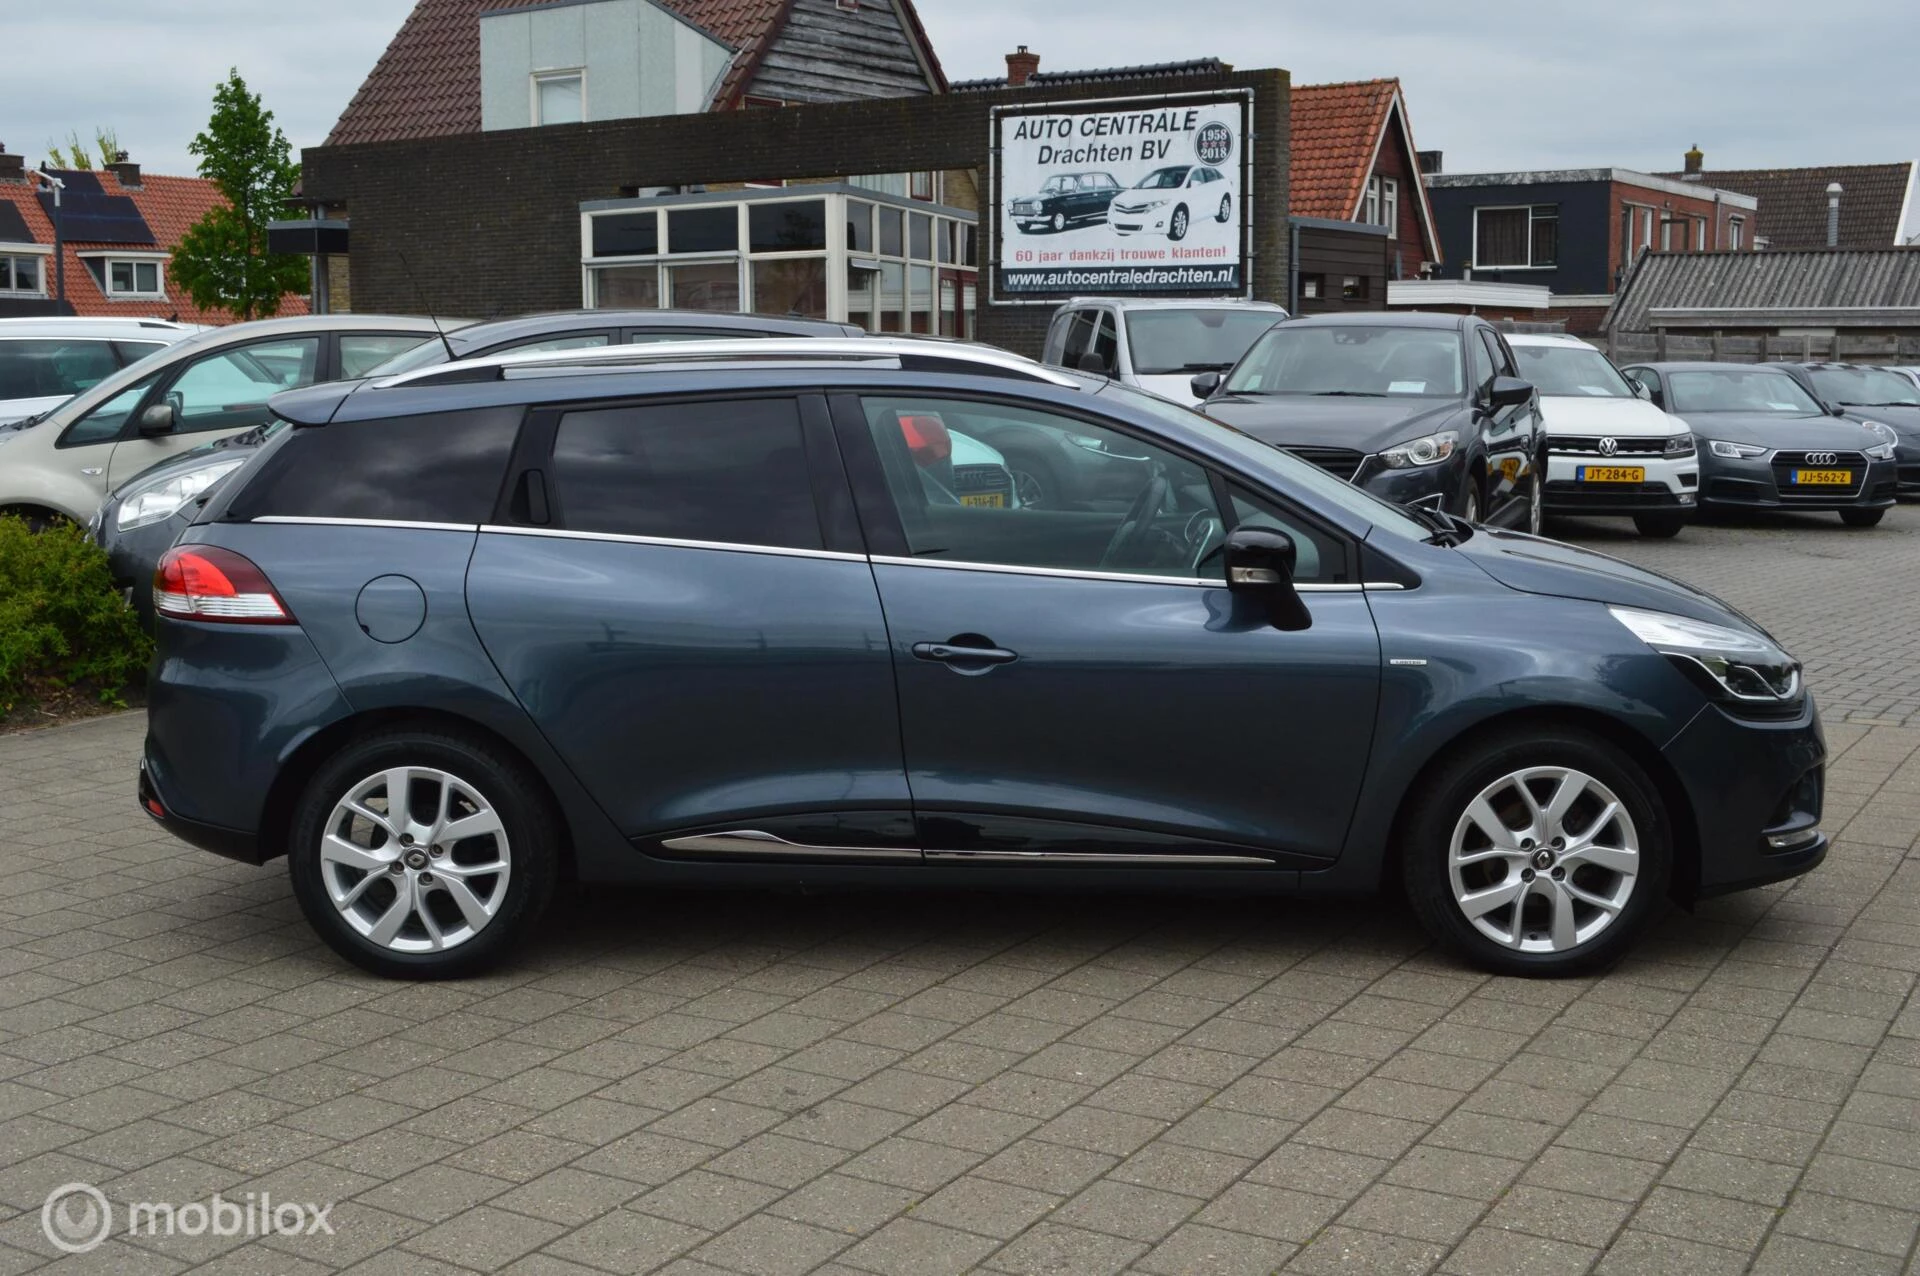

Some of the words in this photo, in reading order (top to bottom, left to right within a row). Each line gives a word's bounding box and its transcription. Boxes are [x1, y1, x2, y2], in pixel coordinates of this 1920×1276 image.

[1014, 118, 1073, 140] AUTO
[1080, 111, 1199, 136] CENTRALE
[1202, 128, 1227, 141] 1958
[1038, 143, 1133, 165] Drachten
[1140, 139, 1171, 160] BV
[1200, 147, 1227, 159] 2018
[1015, 249, 1033, 262] 60
[1039, 250, 1063, 263] jaar
[1069, 248, 1115, 262] dankzij
[1120, 248, 1166, 260] trouwe
[1172, 245, 1227, 258] klanten!
[1008, 266, 1234, 286] www.autocentraledrachten.nl
[1589, 469, 1639, 480] JT-284-G
[1801, 472, 1846, 482] JJ-562-Z
